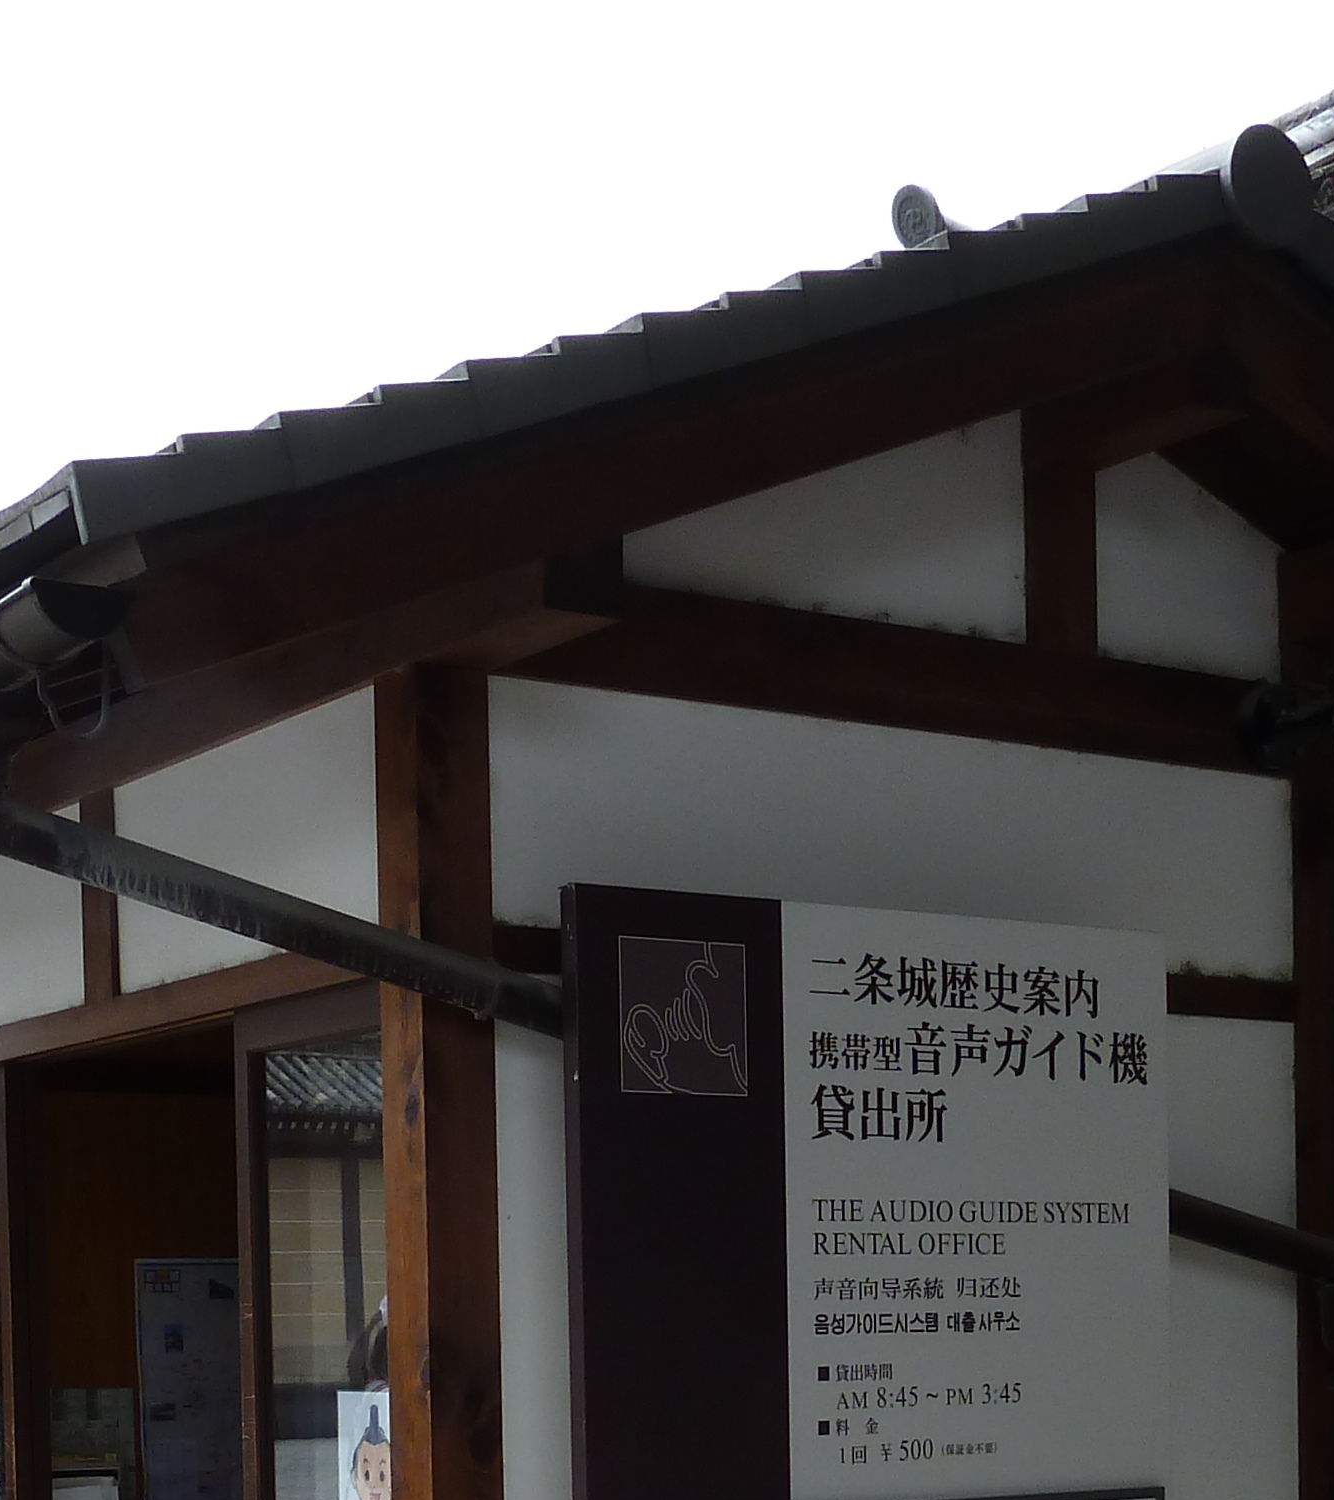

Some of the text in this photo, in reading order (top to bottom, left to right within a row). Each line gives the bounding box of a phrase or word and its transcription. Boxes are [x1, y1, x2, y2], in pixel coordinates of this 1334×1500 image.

[809, 952, 1100, 1019] 二条城歴史案内
[811, 1083, 948, 1143] 貸出所
[812, 1198, 1131, 1225] THE AUDIO GUIDE SYSTEM
[812, 1232, 1007, 1256] RENTAL OFFICE
[813, 1311, 940, 1335] 음성가이드시스템
[835, 1363, 894, 1383] 貸出時間
[836, 1392, 868, 1410] AM
[877, 1386, 919, 1409] 8:45
[946, 1387, 973, 1405] PM
[981, 1382, 1022, 1404] 3:45
